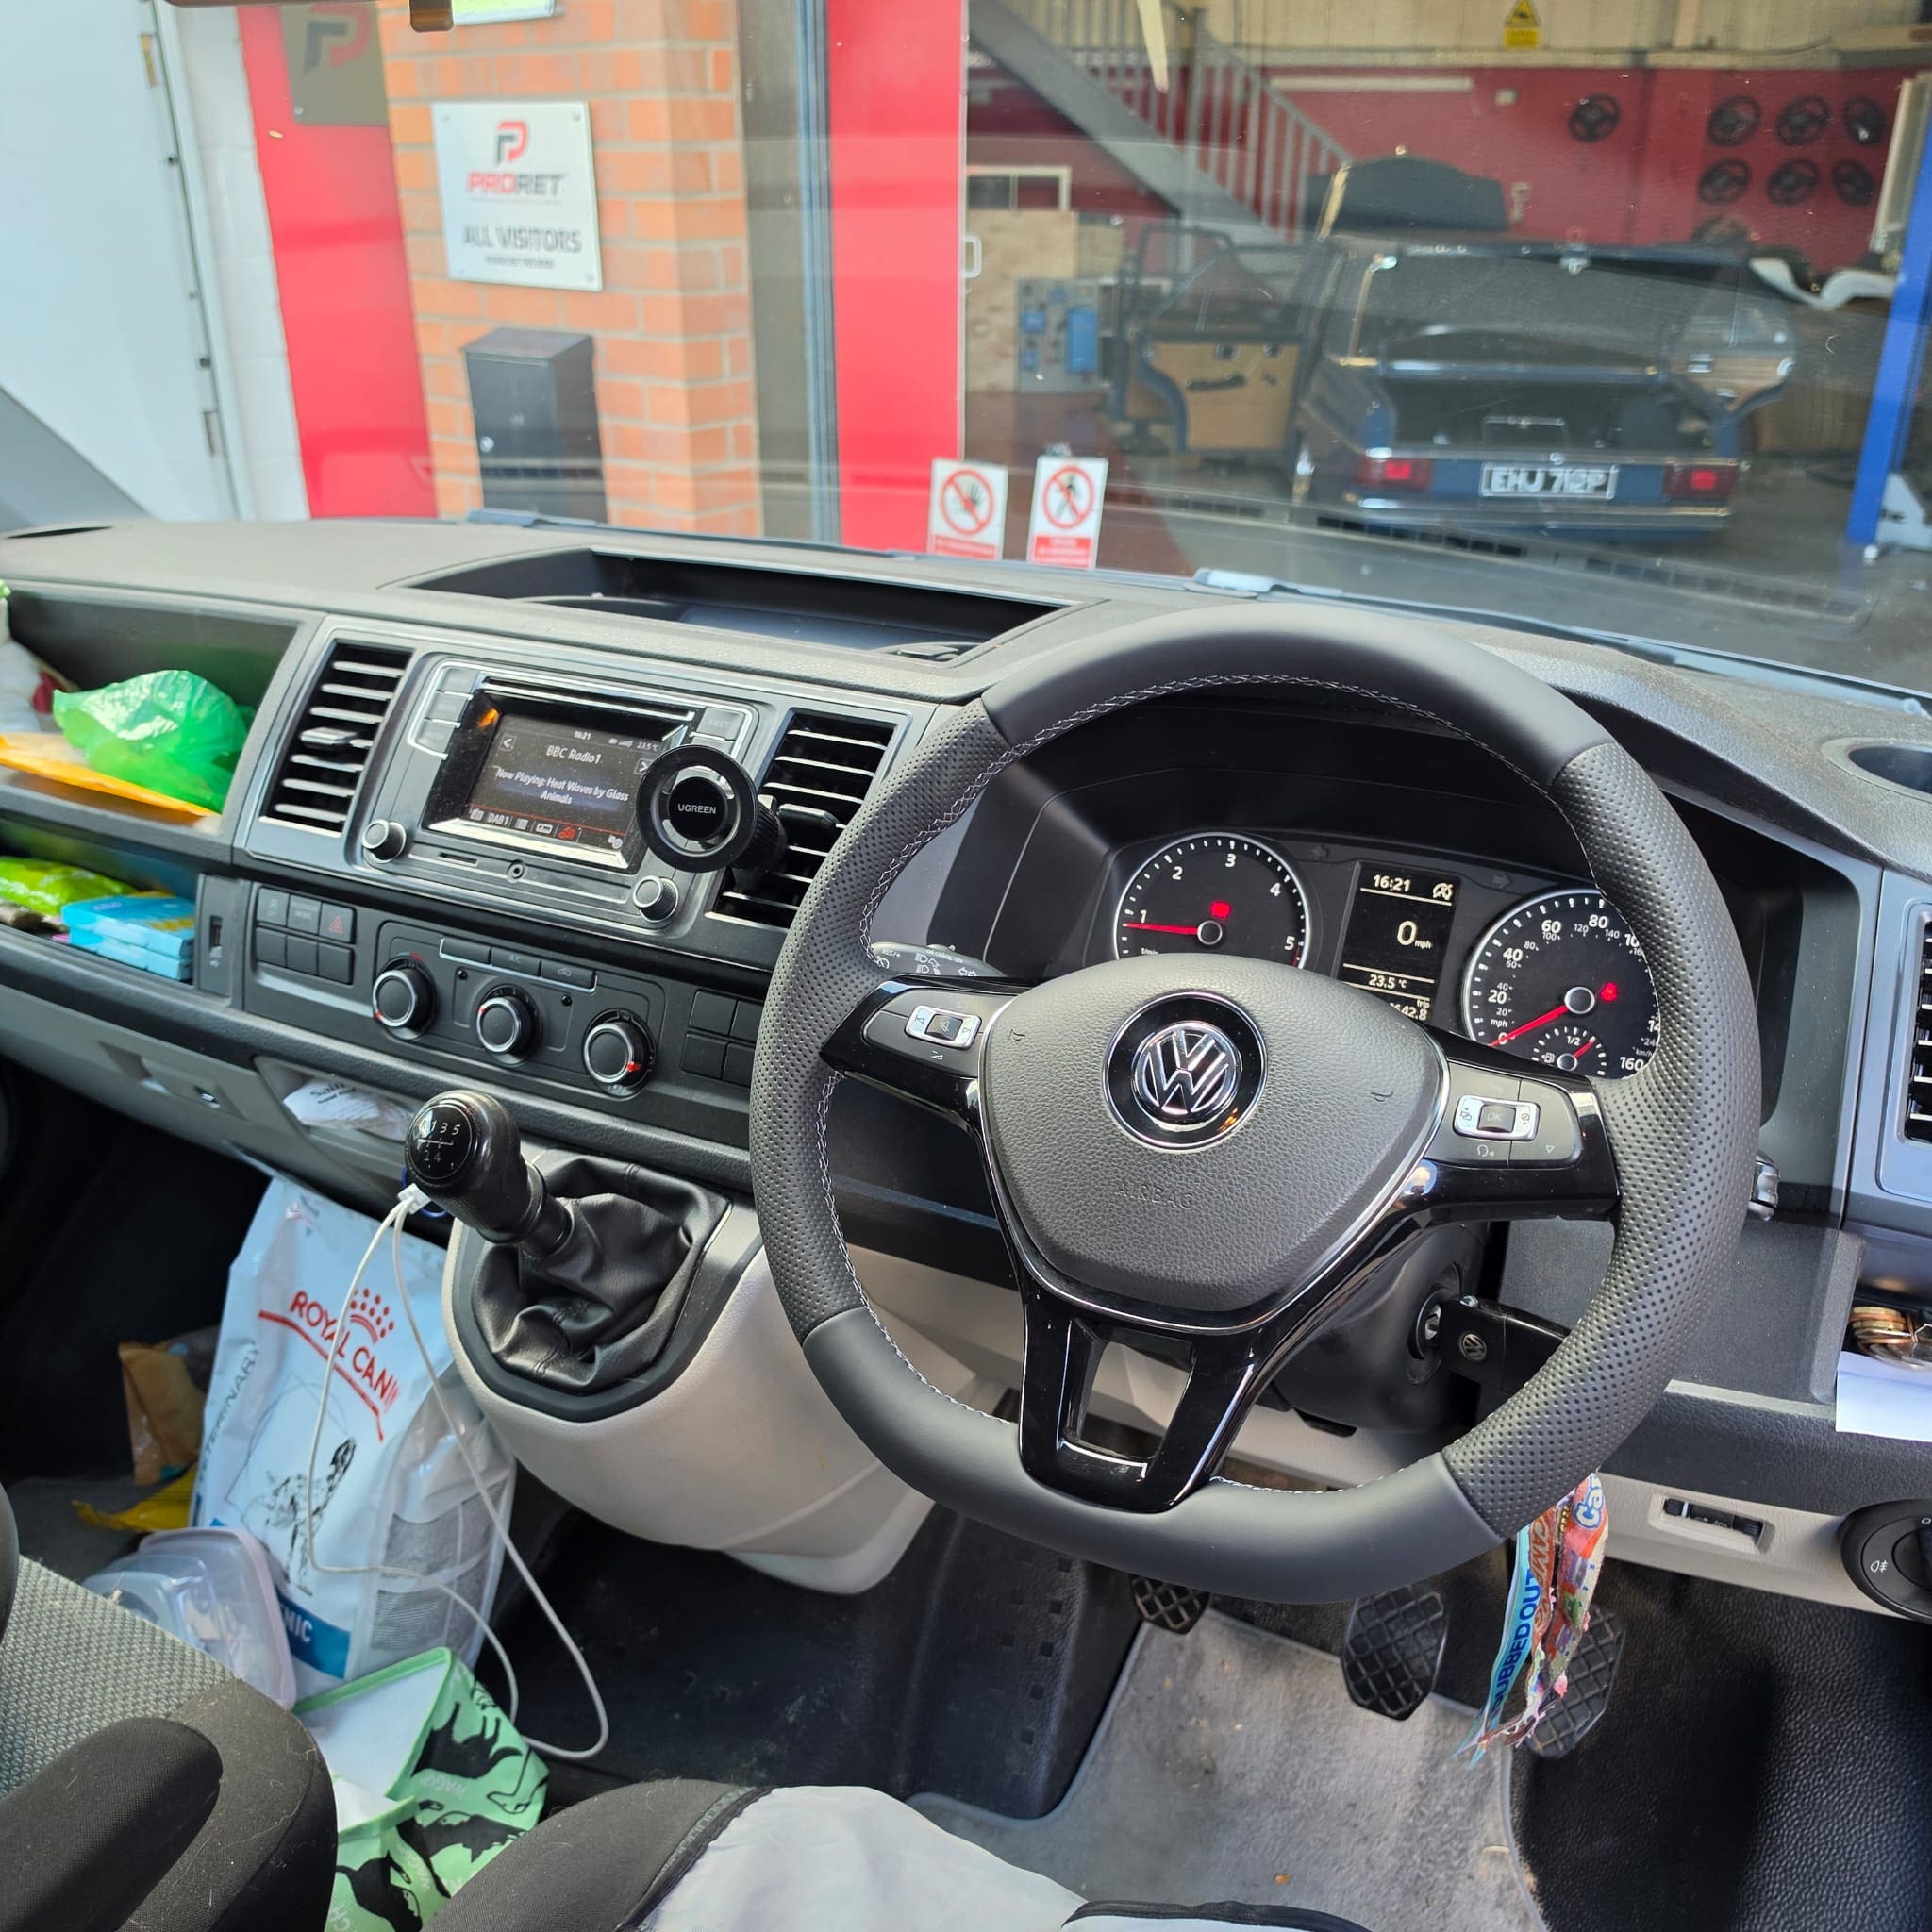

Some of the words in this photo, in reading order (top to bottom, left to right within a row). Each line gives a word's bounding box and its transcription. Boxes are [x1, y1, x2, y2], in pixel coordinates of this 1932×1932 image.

[496, 225, 583, 254] VISITORS
[546, 744, 566, 758] BBC
[496, 766, 515, 780] Now
[546, 775, 566, 790] Heat
[566, 778, 593, 794] Waves
[593, 785, 605, 798] by
[605, 788, 629, 802] Glass
[541, 790, 573, 805] Animals
[677, 803, 717, 814] UGREEN
[1225, 853, 1236, 867] 3
[1172, 866, 1183, 880] 2
[1270, 882, 1281, 896] 4
[1374, 874, 1411, 892] 16:21
[1140, 909, 1147, 924] 1
[1588, 914, 1608, 928] 80
[1541, 920, 1561, 933] 60
[1574, 924, 1589, 933] 120
[1605, 928, 1620, 939] 140
[1397, 920, 1417, 946] 0
[1415, 939, 1433, 950] mph
[1542, 931, 1557, 941] 100
[1284, 936, 1295, 950] 5
[1524, 941, 1536, 950] 80
[1503, 948, 1523, 961] 40
[1506, 960, 1518, 969] 60
[1369, 974, 1396, 989] 23.5
[1497, 982, 1508, 991] 40
[1416, 999, 1430, 1008] trip
[1488, 990, 1507, 1004] 20
[1496, 1008, 1507, 1016] 20
[1491, 1018, 1507, 1028] mph
[1567, 1035, 1580, 1046] 1/2
[1620, 1057, 1644, 1072] 160
[1487, 1111, 1503, 1123] OK
[440, 1122, 449, 1133] 3
[451, 1124, 461, 1135] 5
[289, 1289, 350, 1358] ROYAL
[1519, 1568, 1541, 1621] OUT
